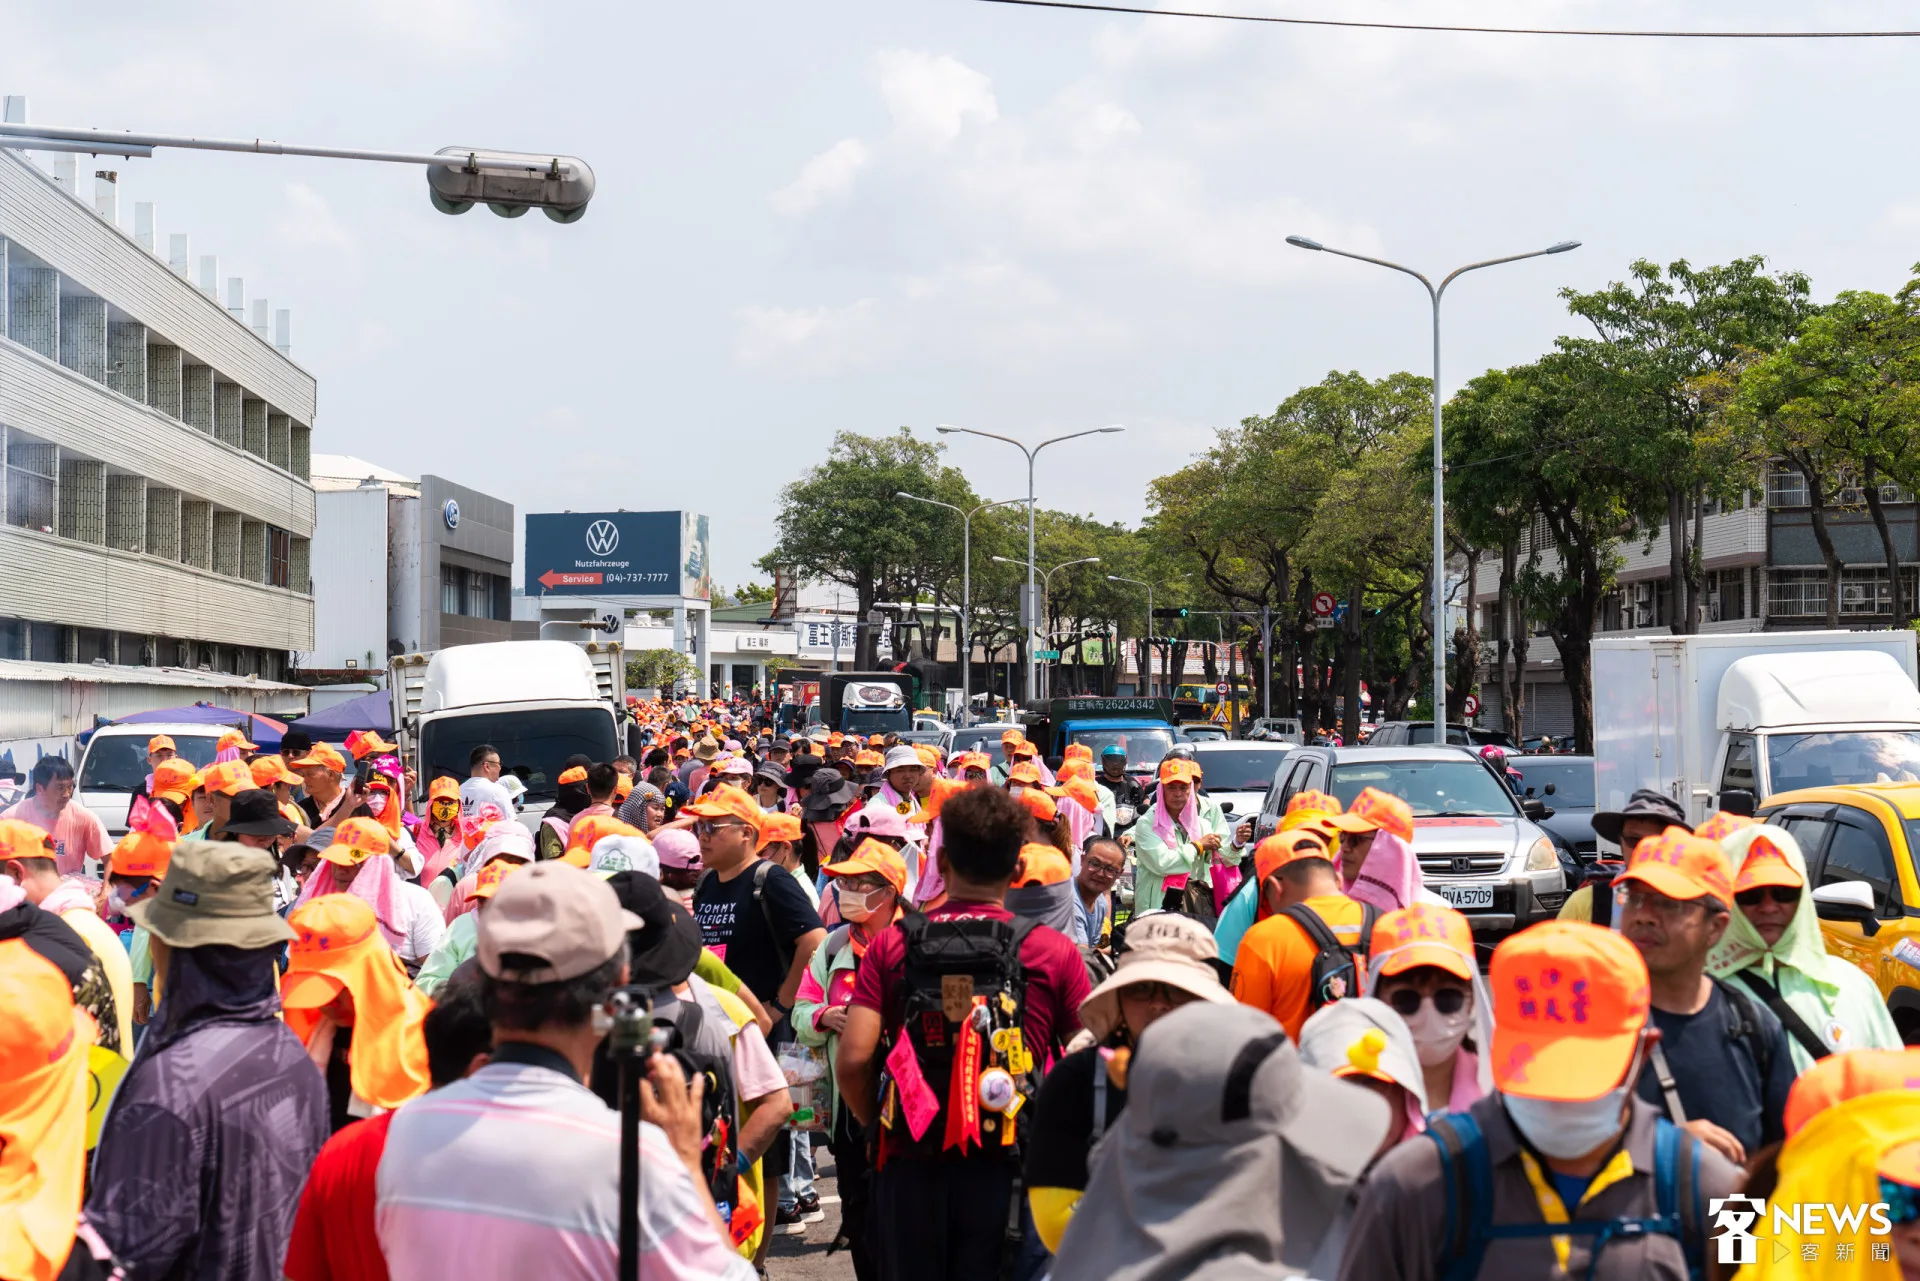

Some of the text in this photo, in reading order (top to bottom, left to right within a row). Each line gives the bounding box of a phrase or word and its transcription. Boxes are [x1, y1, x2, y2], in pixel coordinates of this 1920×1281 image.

[575, 560, 630, 569] Nutzfahrzeuge
[562, 573, 669, 583] Service (04)-737-7777
[1105, 699, 1155, 710] 26224342
[699, 902, 737, 914] TOMMY
[693, 913, 736, 925] HILFIGER
